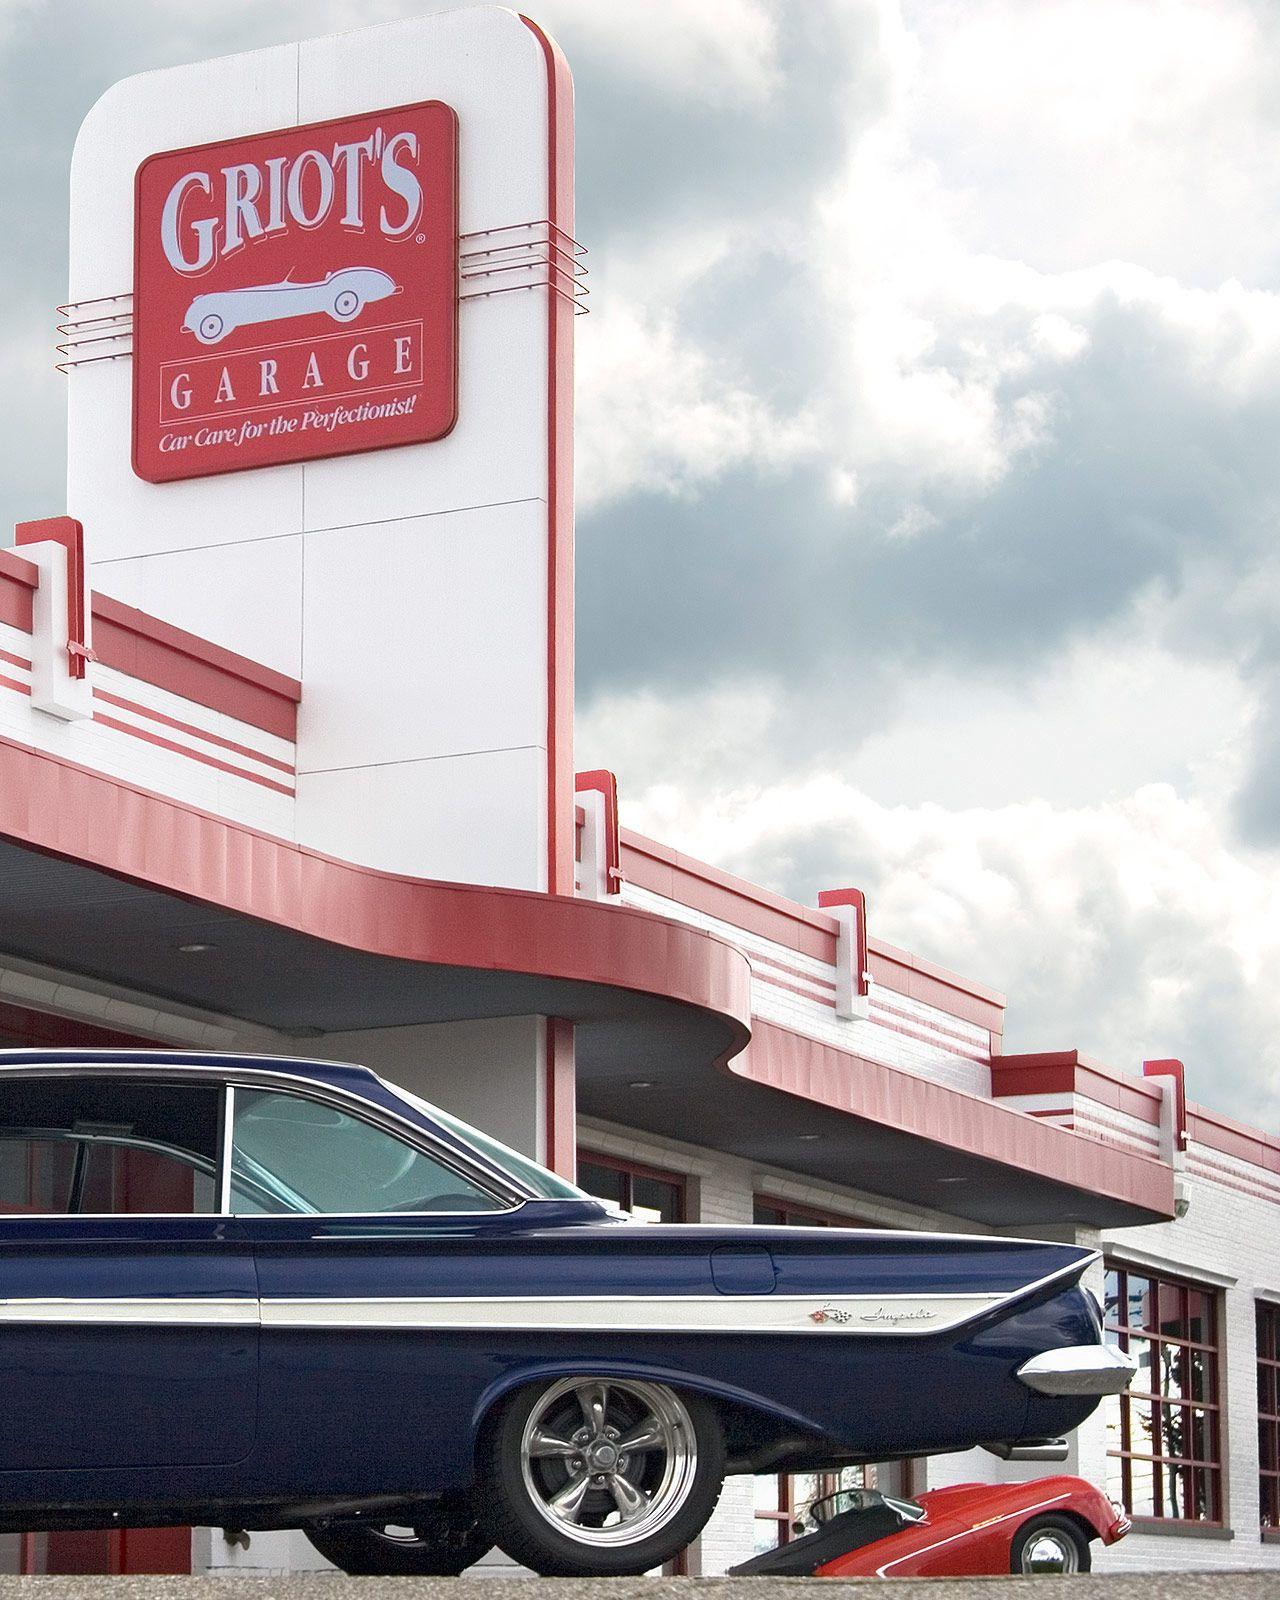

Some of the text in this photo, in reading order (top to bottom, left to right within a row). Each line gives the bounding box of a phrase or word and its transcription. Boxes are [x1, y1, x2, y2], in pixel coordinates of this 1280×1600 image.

[161, 127, 423, 277] GRIOT'S
[170, 336, 413, 409] GARAGE
[158, 394, 418, 453] Car Care for the Perfectionist!
